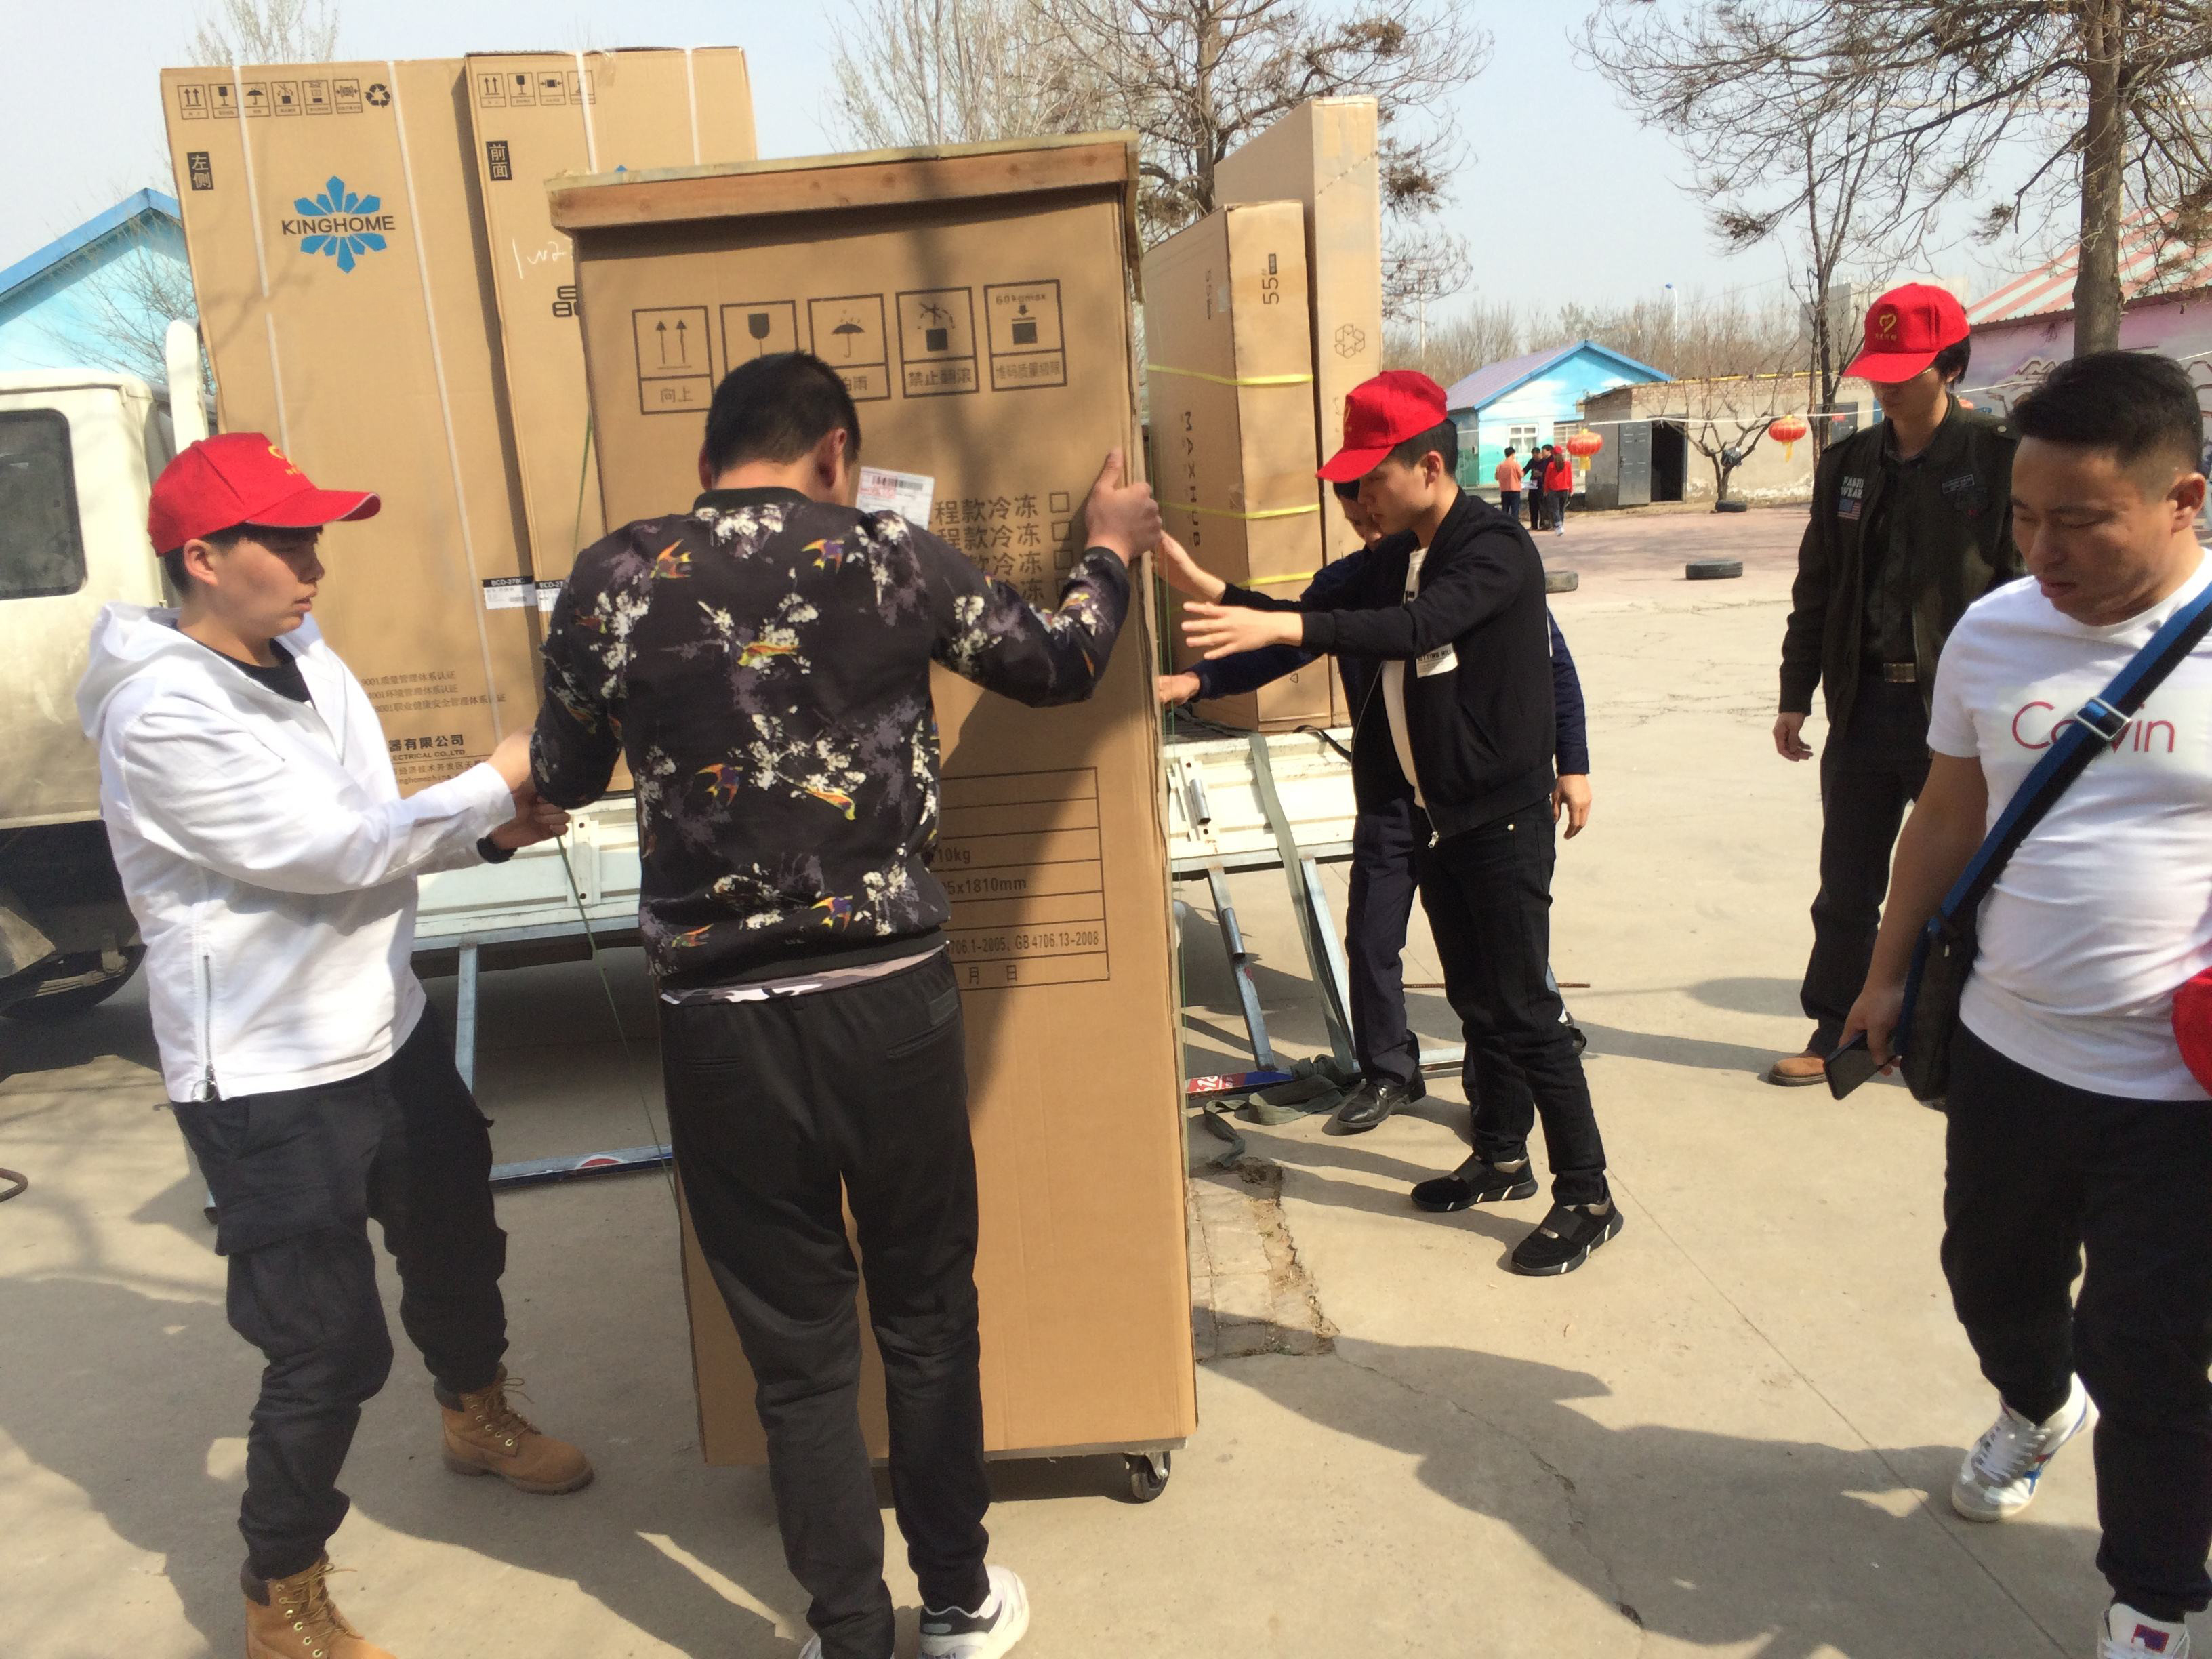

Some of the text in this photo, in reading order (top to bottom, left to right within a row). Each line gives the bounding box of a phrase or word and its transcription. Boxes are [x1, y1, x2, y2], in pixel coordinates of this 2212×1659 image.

[191, 155, 211, 189] 左侧
[489, 144, 508, 179] 前面
[281, 216, 396, 235] KINGHOME
[660, 386, 693, 403] 向上
[935, 493, 1039, 526] 程款冷冻
[2011, 701, 2175, 754] Cvin
[969, 964, 1017, 985] 月 日
